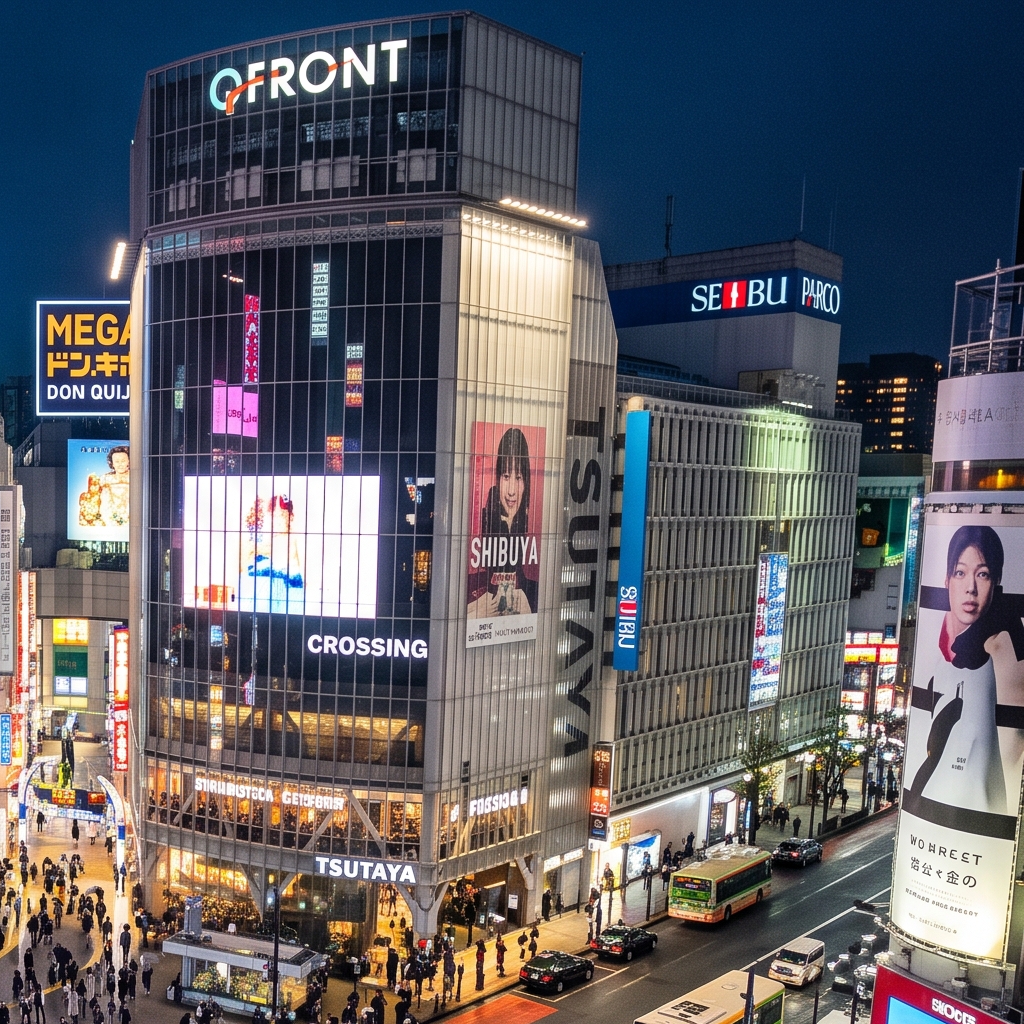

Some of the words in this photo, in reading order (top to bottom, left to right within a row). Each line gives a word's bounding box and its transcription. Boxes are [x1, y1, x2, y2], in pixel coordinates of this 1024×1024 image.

[209, 39, 408, 116] QFRONT
[47, 384, 85, 400] DON
[470, 535, 539, 569] SHIBUYA
[307, 634, 428, 659] CROSSING
[315, 856, 416, 884] TSUTAYA
